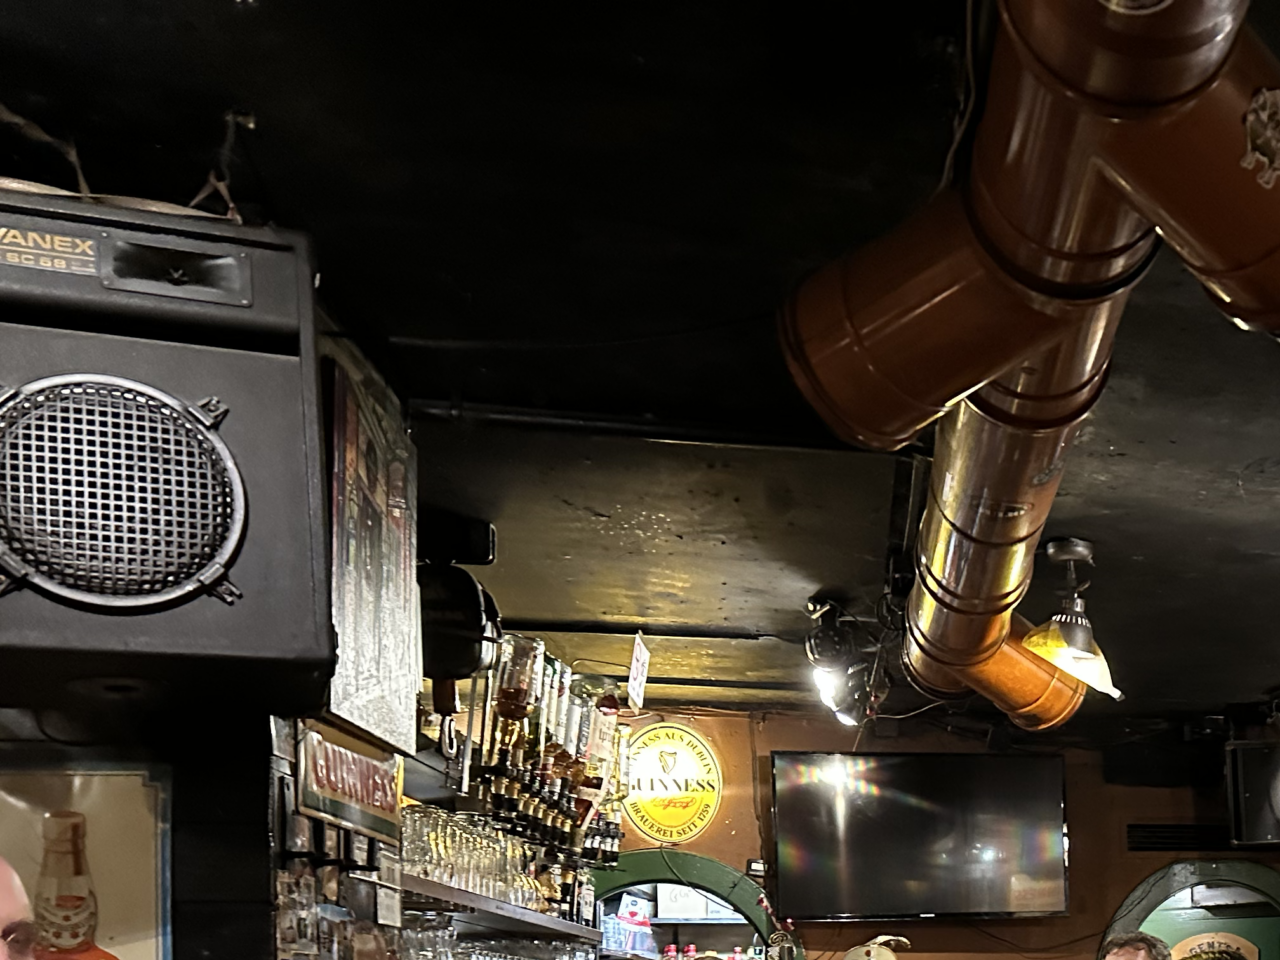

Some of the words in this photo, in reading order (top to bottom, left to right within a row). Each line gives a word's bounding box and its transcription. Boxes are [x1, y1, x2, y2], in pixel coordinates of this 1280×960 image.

[6, 252, 35, 265] SC
[664, 731, 685, 743] AUS
[686, 740, 714, 775] DUBLIN
[631, 777, 716, 794] UINNESS
[629, 802, 674, 838] BRAUEREI
[676, 820, 699, 838] SEIT
[698, 803, 712, 822] 1759
